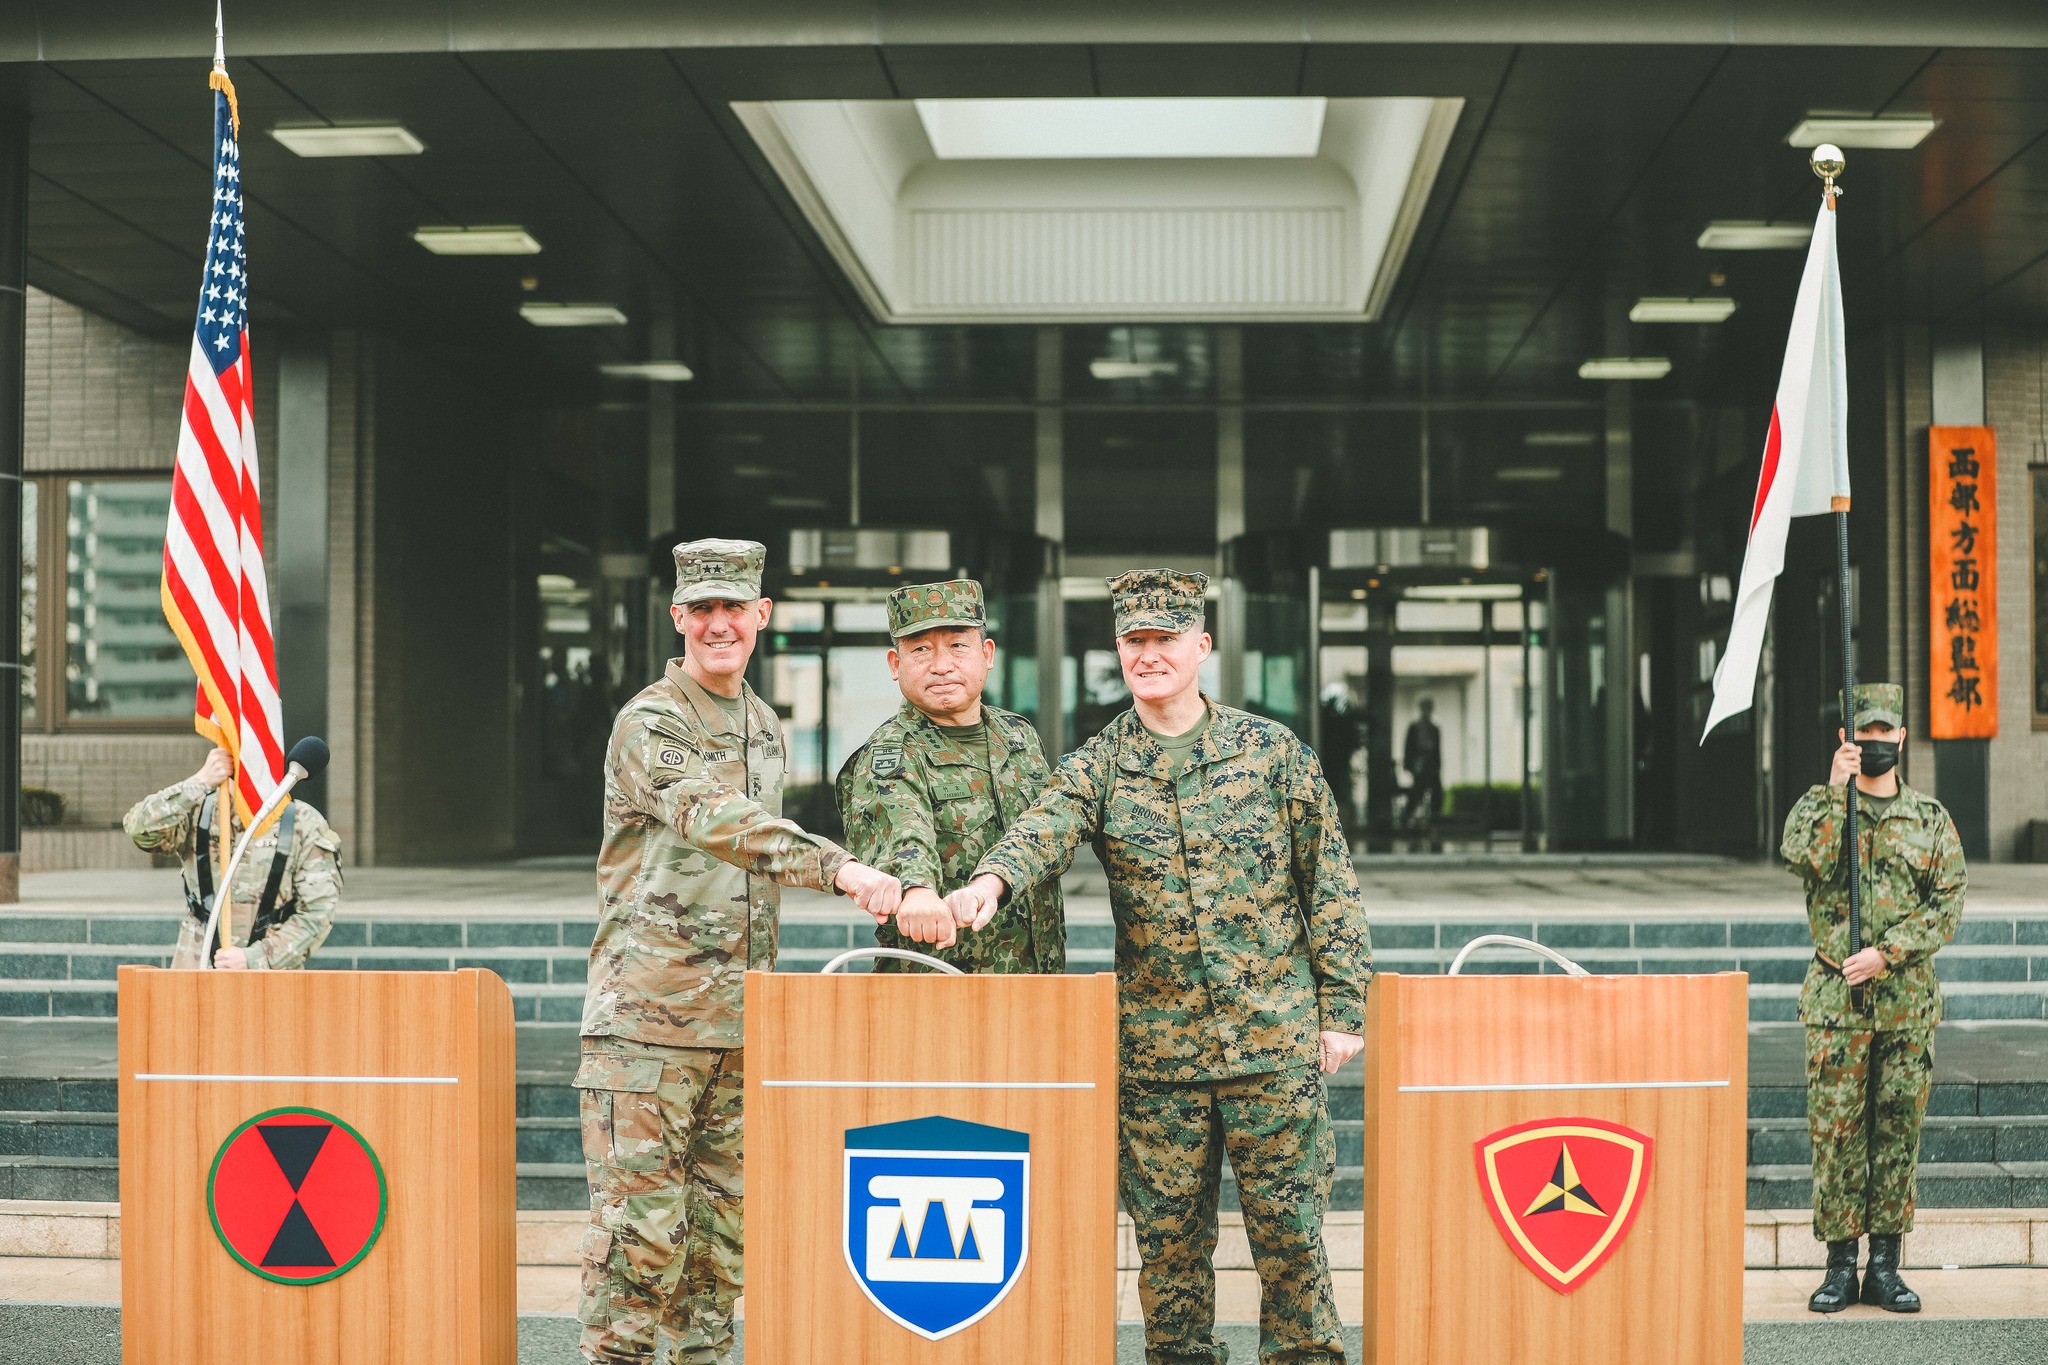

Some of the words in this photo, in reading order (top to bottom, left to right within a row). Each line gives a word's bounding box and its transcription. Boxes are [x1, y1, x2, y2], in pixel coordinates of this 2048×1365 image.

[704, 751, 727, 761] SMITH
[1131, 804, 1168, 826] BROOKS
[1215, 813, 1233, 826] U.S.
